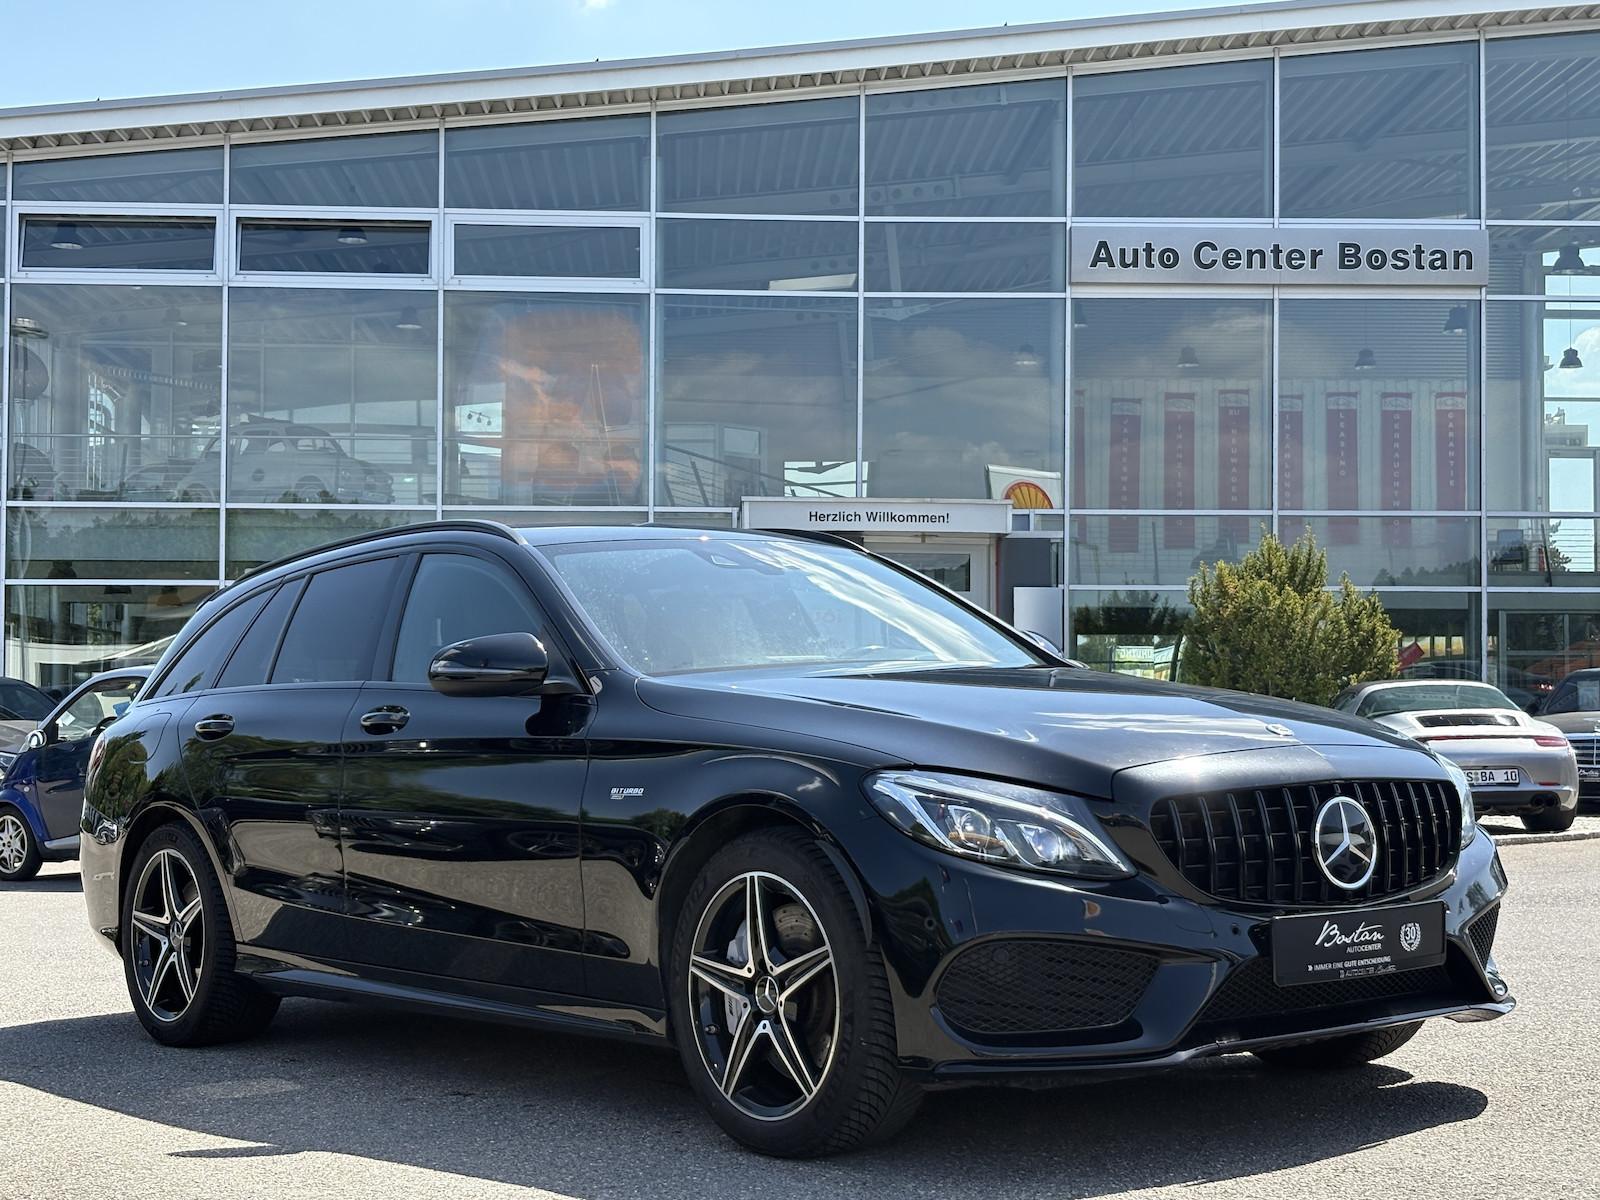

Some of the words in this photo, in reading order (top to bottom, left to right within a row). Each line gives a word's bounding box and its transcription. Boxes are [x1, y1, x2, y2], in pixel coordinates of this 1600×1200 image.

[1088, 239, 1181, 271] Auto
[1191, 240, 1324, 272] Center
[1336, 241, 1475, 272] Bostan
[1447, 411, 1456, 488] GARANTIE
[808, 510, 862, 523] Herzlich
[865, 511, 950, 524] Willkommen!
[1463, 771, 1474, 782] S
[1480, 771, 1495, 782] BA
[1503, 770, 1517, 782] 10
[1314, 919, 1385, 948] Bostan
[1405, 926, 1416, 940] 30
[1346, 942, 1382, 954] AUTOCENTER
[1313, 963, 1332, 971] IMMER
[1333, 961, 1343, 969] EINE
[1343, 960, 1357, 968] GUTE
[1357, 955, 1391, 967] ENTSCHEIDUNG
